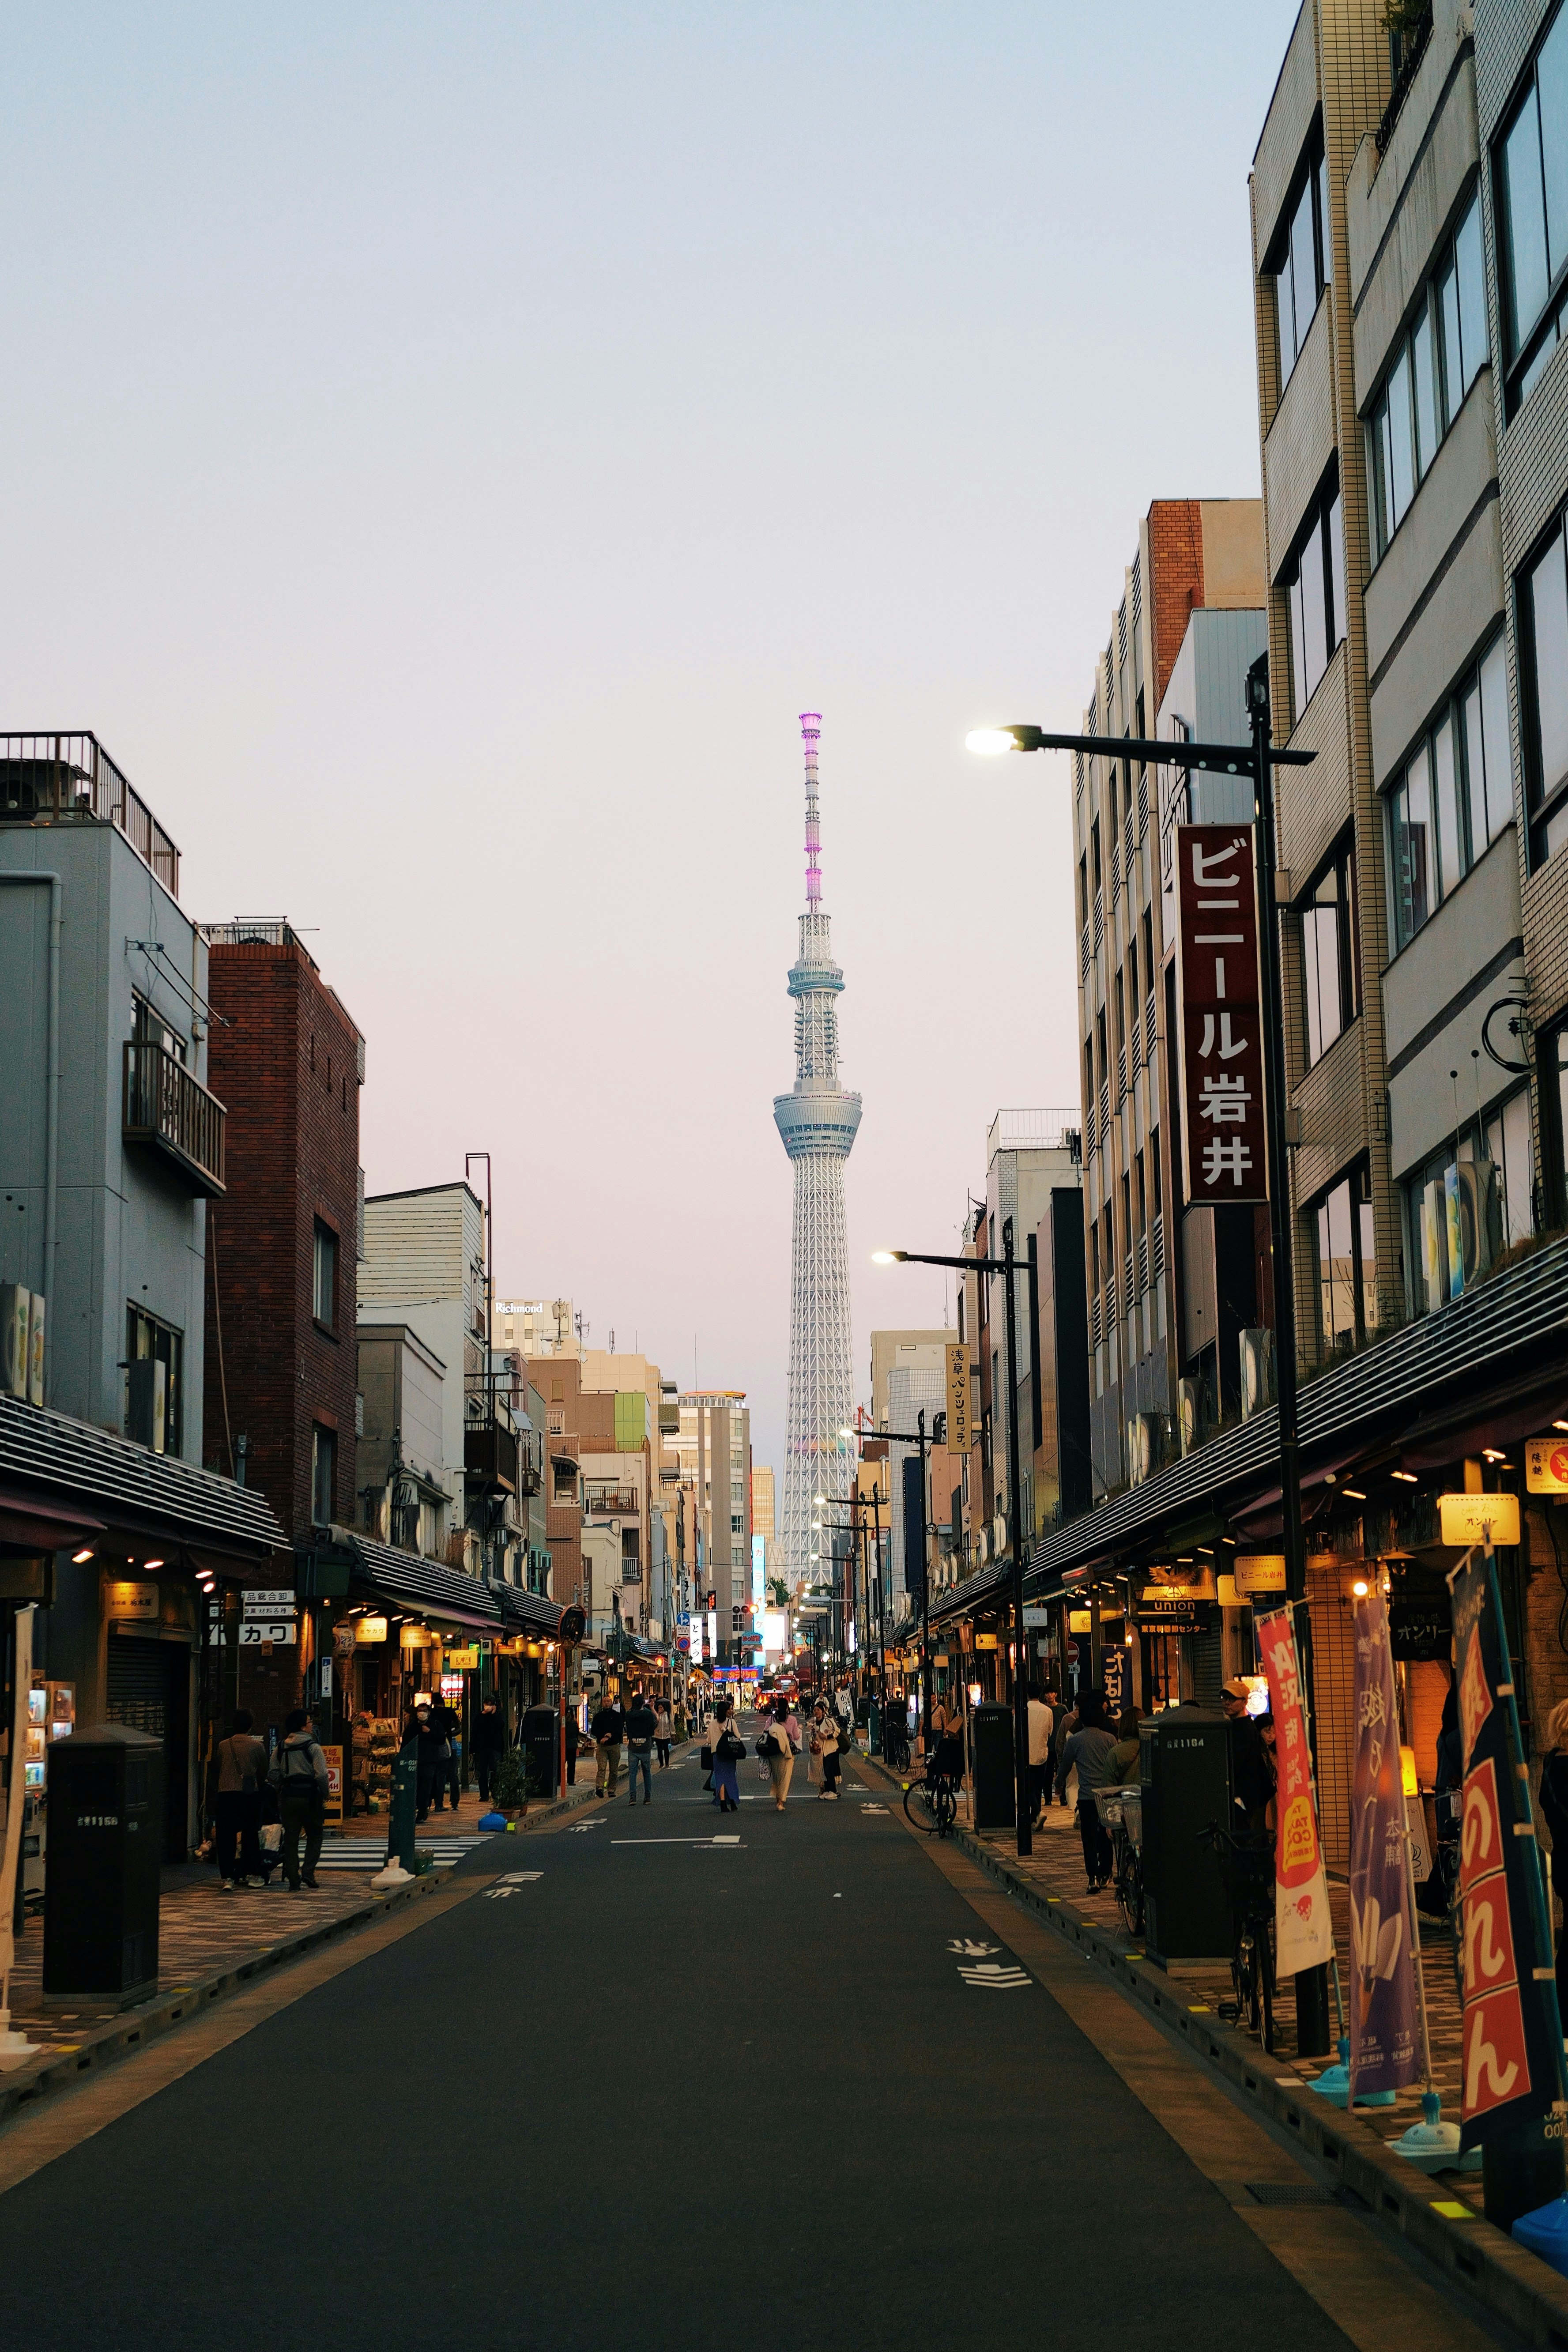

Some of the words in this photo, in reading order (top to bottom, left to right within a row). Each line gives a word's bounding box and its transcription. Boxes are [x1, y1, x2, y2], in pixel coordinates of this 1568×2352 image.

[1192, 838, 1252, 1186] ビニール岩井
[495, 1302, 543, 1314] Richmond
[950, 1349, 965, 1447] 浅草パンツェロッティ
[1241, 1571, 1283, 1579] ビニール岩井
[754, 1549, 763, 1629] カラオケ
[1154, 1601, 1195, 1611] union
[1398, 1625, 1452, 1640] オンリー
